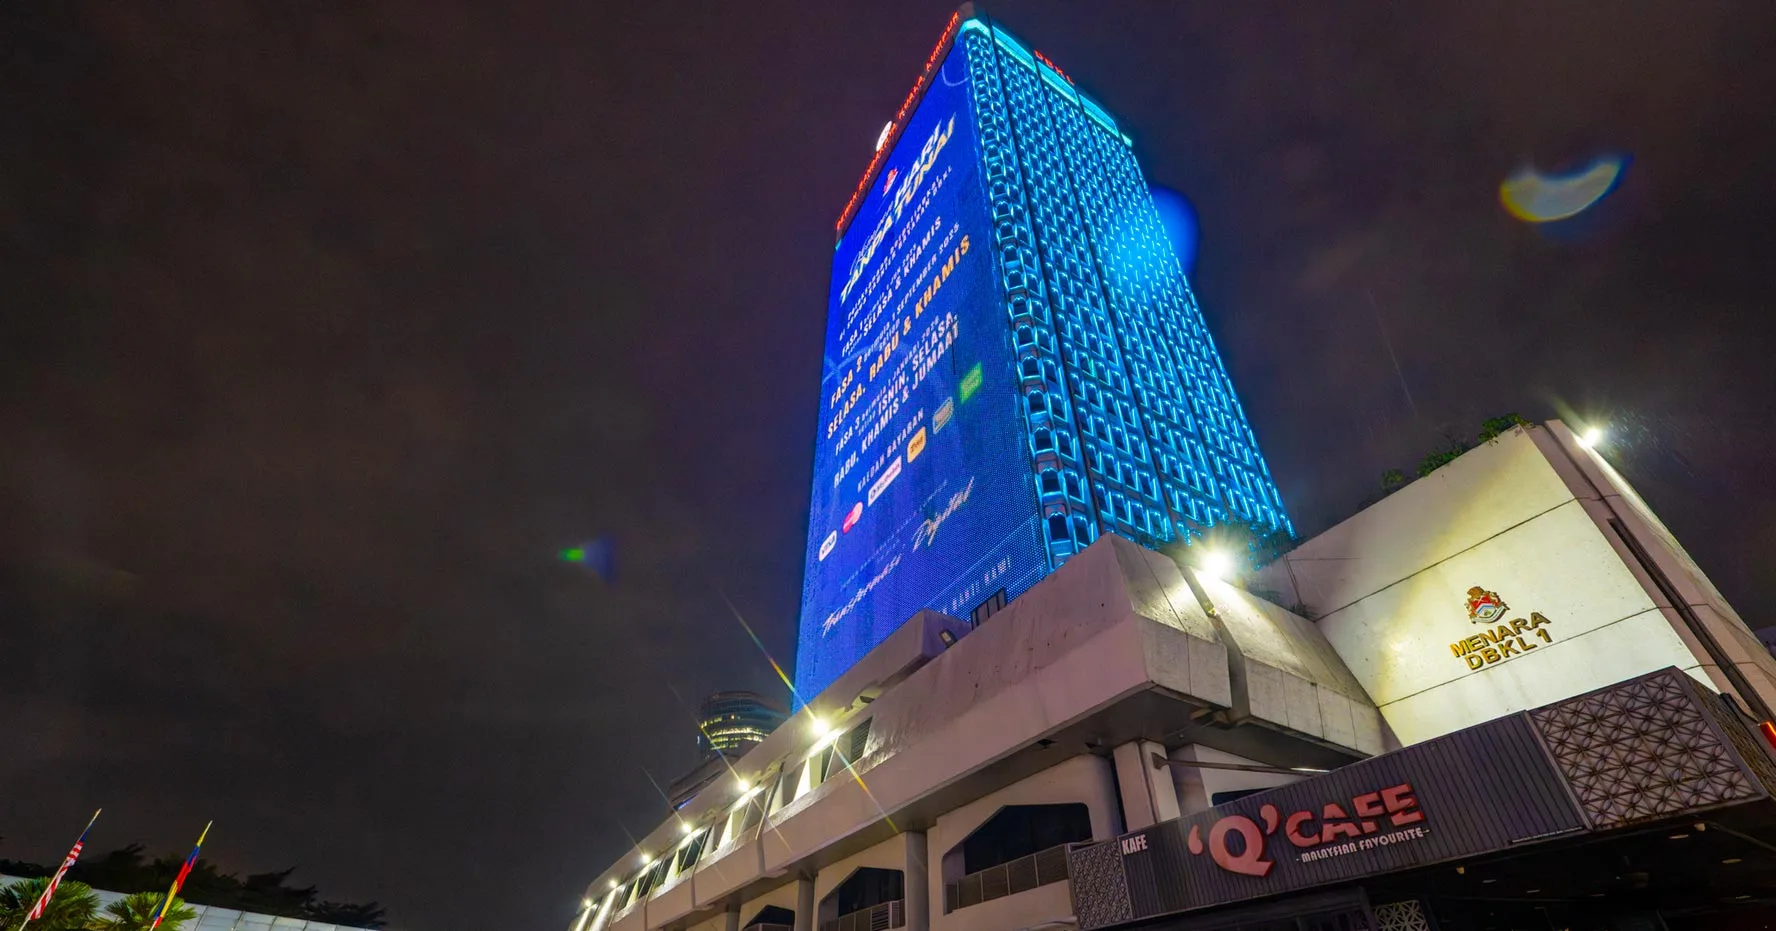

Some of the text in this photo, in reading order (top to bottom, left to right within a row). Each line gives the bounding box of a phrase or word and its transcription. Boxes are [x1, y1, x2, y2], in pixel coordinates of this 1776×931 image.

[863, 288, 893, 337] SELASA
[903, 216, 941, 277] KHAMIS
[869, 330, 899, 382] RABU
[902, 315, 912, 336] &
[915, 234, 970, 319] KHAMIS
[830, 369, 854, 409] FASA
[896, 253, 937, 315] SEPTEMBER
[861, 397, 899, 454] KHAMIS
[911, 321, 959, 391] JUMAAT
[835, 426, 853, 456] FASA
[1450, 612, 1552, 658] MENARA
[1465, 628, 1553, 671] DBKL 1
[1121, 834, 1148, 855] KAFE
[1285, 783, 1425, 849] CAFE
